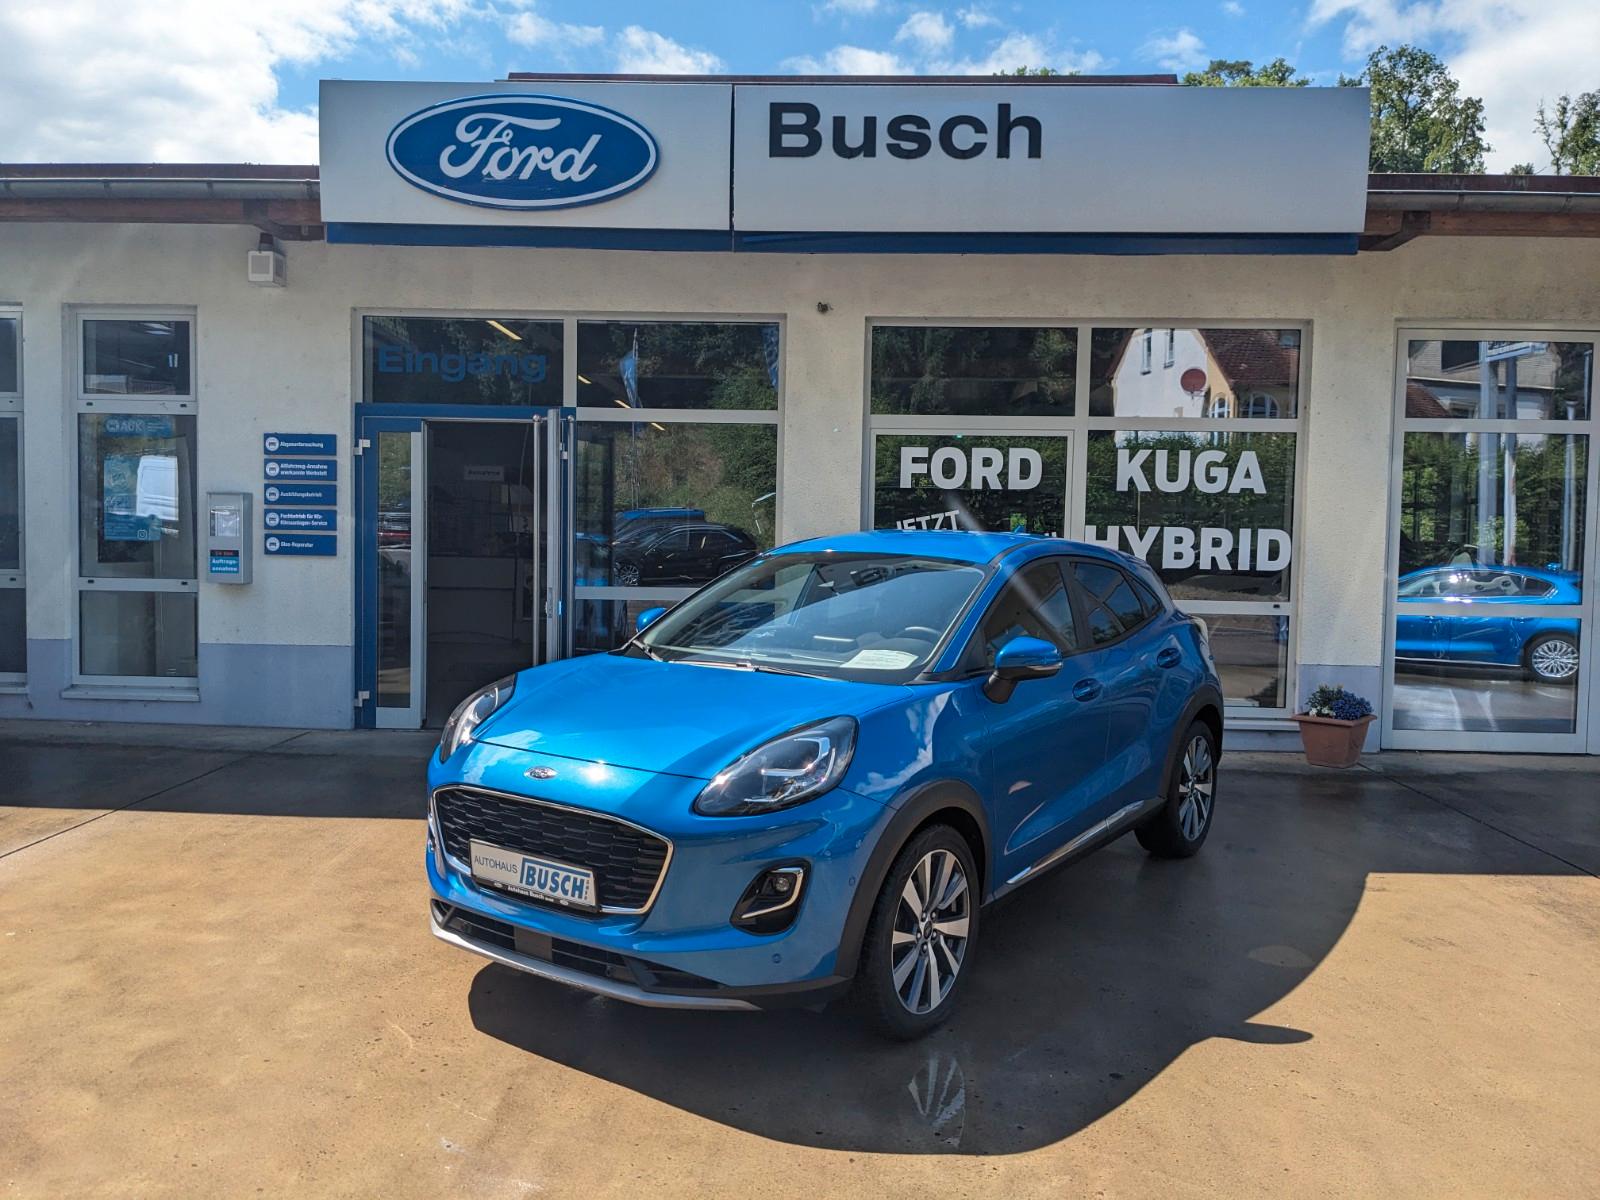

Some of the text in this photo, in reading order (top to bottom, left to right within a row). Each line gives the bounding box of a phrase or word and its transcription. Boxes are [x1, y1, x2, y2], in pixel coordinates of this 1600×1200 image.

[438, 112, 604, 183] Ford
[769, 101, 1042, 160] Busch
[378, 345, 547, 383] Eingang
[900, 446, 1267, 495] FORD KUGA
[1085, 525, 1292, 572] HYBRID
[474, 855, 519, 874] AUTOHAUS
[525, 865, 586, 899] BUSCH
